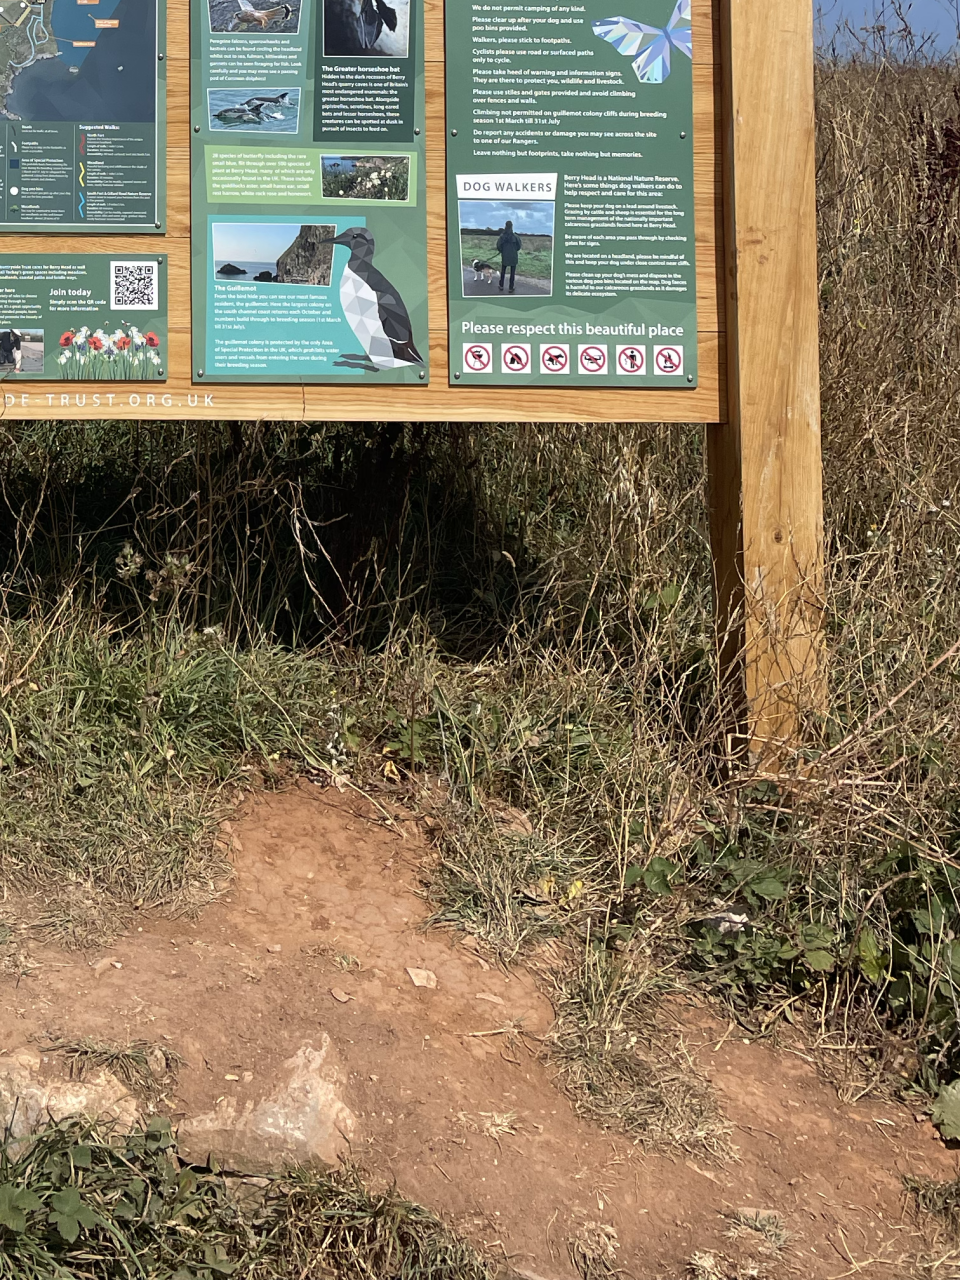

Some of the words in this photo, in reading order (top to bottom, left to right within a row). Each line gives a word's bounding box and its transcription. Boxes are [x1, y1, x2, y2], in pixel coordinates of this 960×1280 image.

[463, 182, 491, 192] DOG
[494, 182, 552, 192] WALKERS
[49, 288, 66, 296] Join
[68, 288, 92, 298] today
[462, 321, 504, 334] Please
[507, 323, 556, 337] respect
[558, 322, 583, 335] this
[586, 322, 645, 336] beautiful
[648, 323, 684, 339] place
